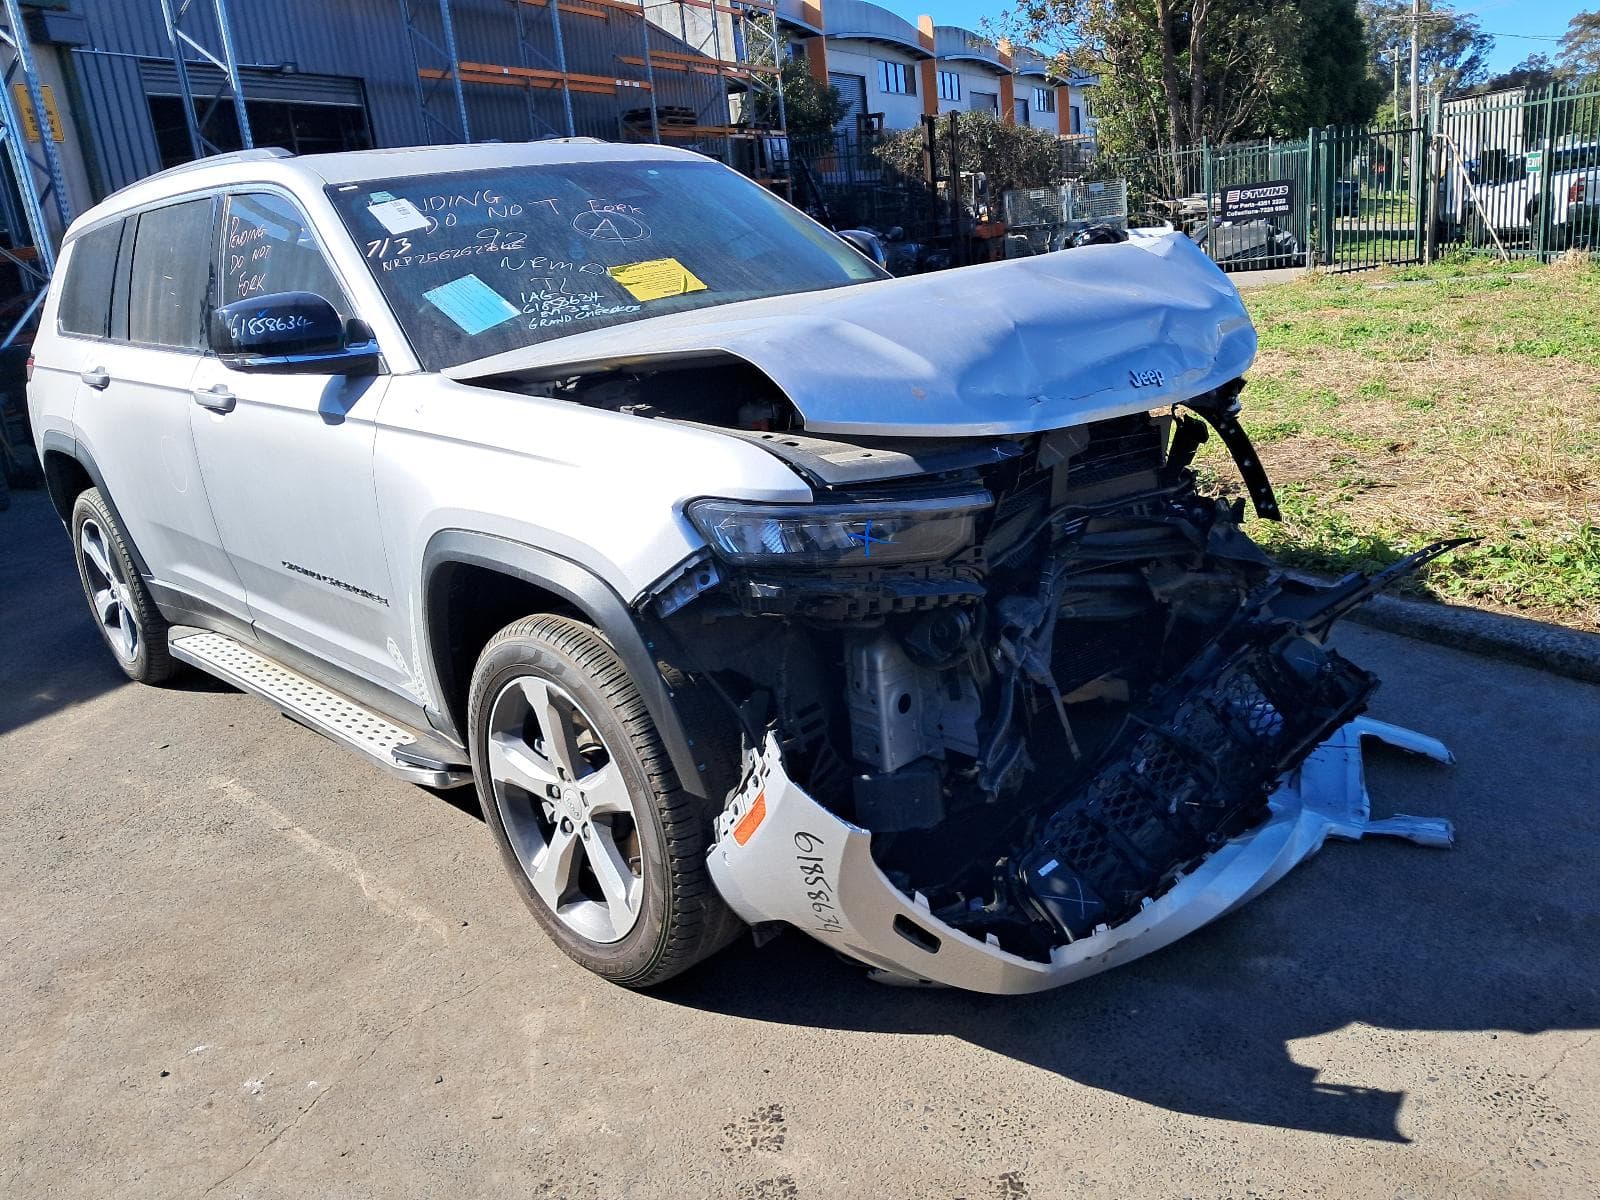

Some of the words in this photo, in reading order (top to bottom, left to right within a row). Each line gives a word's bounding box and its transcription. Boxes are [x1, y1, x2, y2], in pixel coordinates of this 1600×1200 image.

[252, 246, 272, 262] NOT
[238, 271, 265, 297] FORK
[230, 314, 315, 339] 61858634
[1129, 368, 1165, 389] Jeep
[794, 831, 844, 935] 61858634
